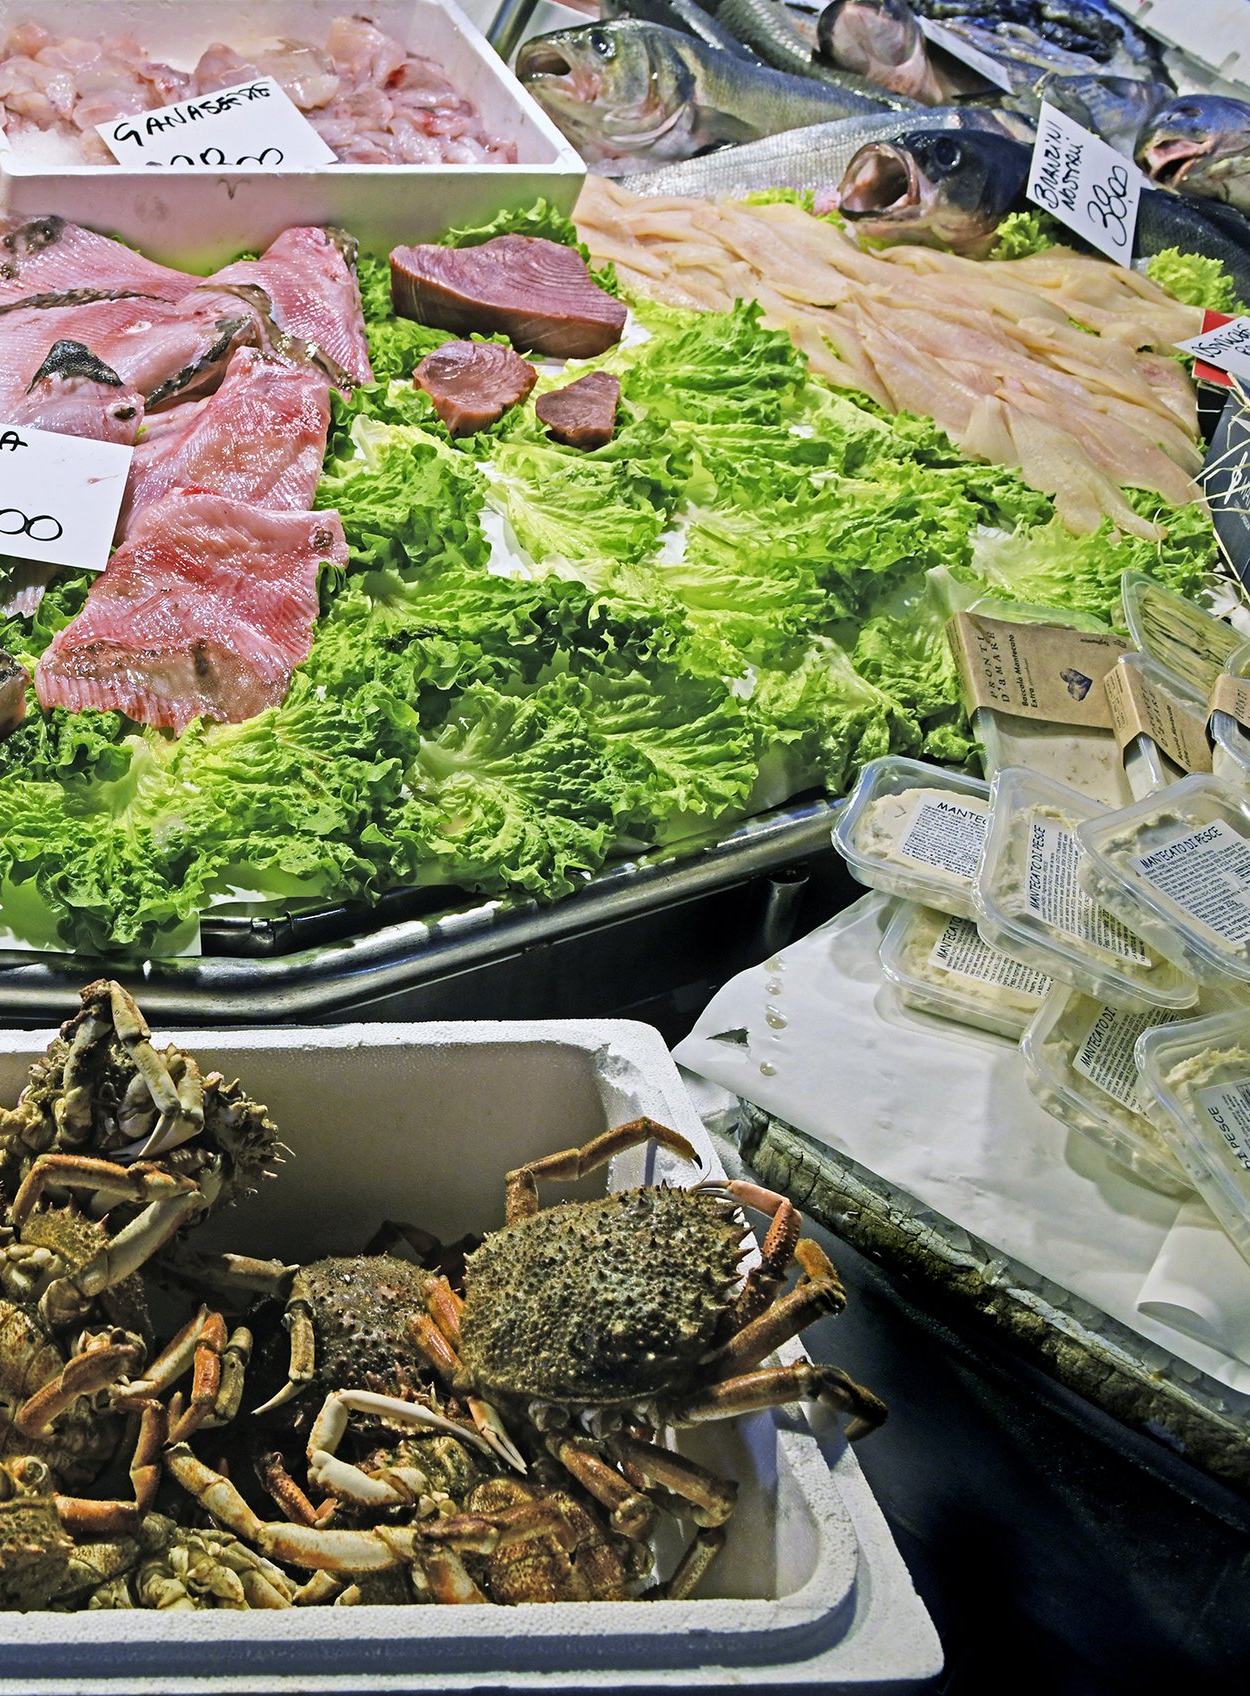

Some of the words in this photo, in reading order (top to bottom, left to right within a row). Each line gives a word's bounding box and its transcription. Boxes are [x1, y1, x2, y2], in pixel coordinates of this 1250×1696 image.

[977, 636, 999, 700] PRONTI
[1007, 633, 1021, 675] Mantecato
[1031, 851, 1042, 861] DI
[1032, 824, 1045, 850] PESCE
[1140, 842, 1186, 870] MANTECATO
[1183, 836, 1198, 851] DI
[1194, 824, 1222, 846] PESCE
[1029, 860, 1042, 910] MANTECATO
[1079, 1019, 1110, 1068] MANTECATO
[1207, 1106, 1240, 1149] PESCE
